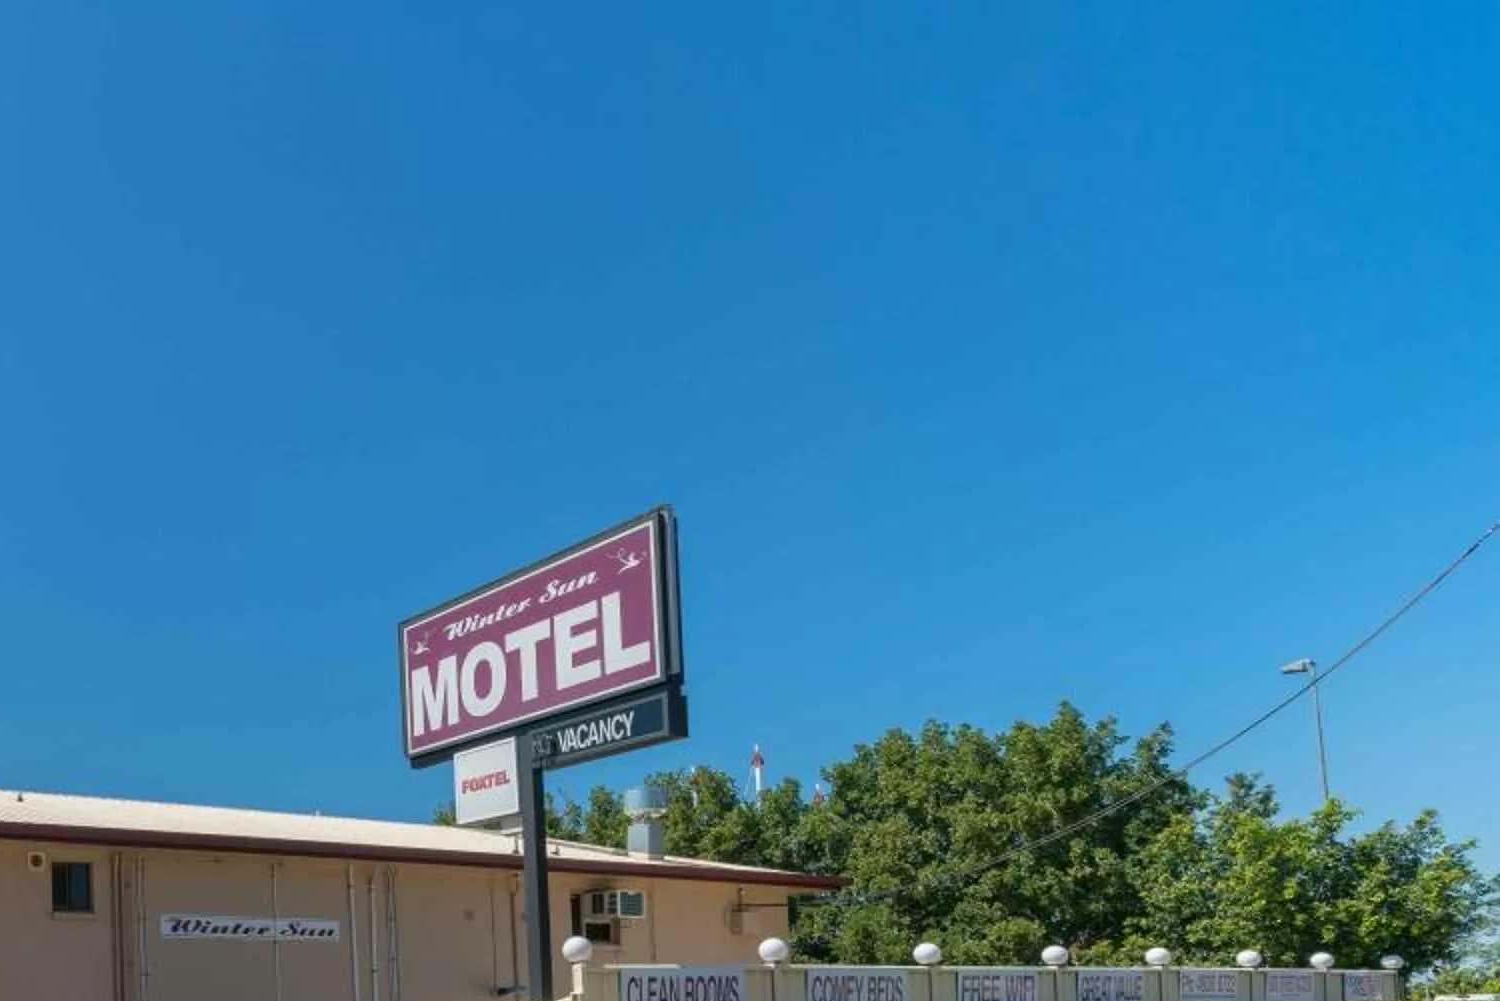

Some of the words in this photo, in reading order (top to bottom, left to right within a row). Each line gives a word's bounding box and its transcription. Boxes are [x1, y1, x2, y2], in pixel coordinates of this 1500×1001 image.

[443, 597, 532, 641] Winter
[538, 570, 599, 605] Sun
[411, 591, 651, 737] MOTEL
[557, 711, 635, 753] VACANCY
[461, 769, 510, 795] FOXTEL
[164, 917, 271, 935] Winter
[279, 919, 336, 937] Sun
